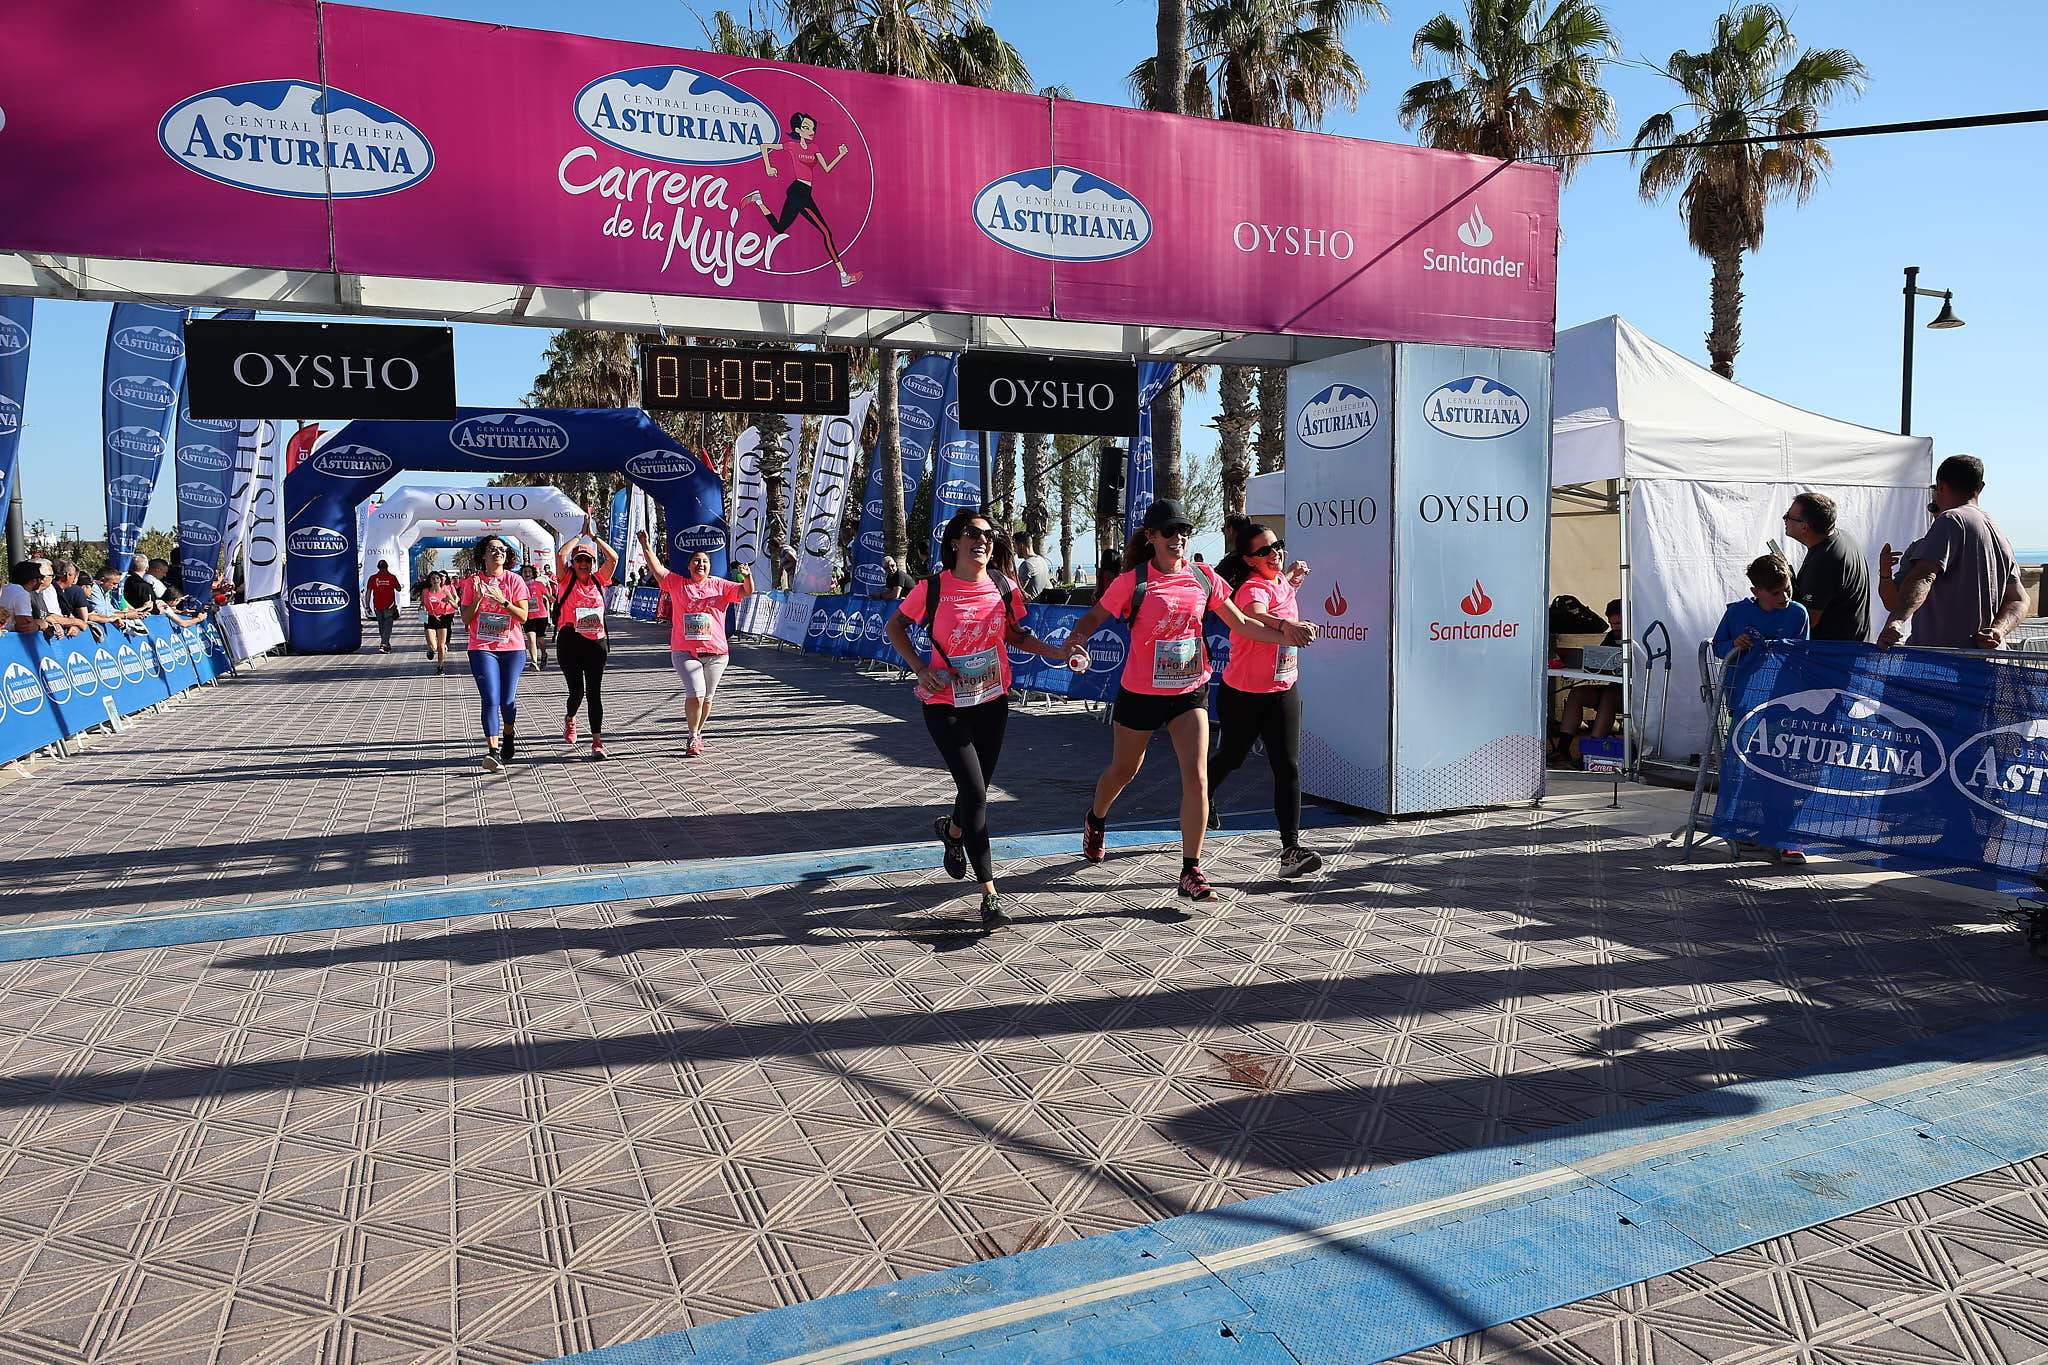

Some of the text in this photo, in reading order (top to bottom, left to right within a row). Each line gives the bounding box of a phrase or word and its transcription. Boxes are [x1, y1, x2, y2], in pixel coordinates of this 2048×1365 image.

[591, 92, 764, 146] ASTURIANA
[623, 93, 760, 119] CENTRAL LECHERA
[224, 114, 311, 133] CENTRAL
[182, 113, 415, 175] ASTURIANA
[558, 146, 728, 209] Carrera
[987, 194, 1140, 241] ASTURIANA
[1015, 195, 1134, 214] CENTRAL LECHERA
[602, 205, 790, 287] de la Mujer
[1233, 222, 1355, 262] OYSHO
[1423, 247, 1525, 279] Santander
[233, 352, 419, 391] OYSHO
[656, 356, 834, 402] 01:05:57
[988, 378, 1115, 411] OYSHO
[1447, 397, 1518, 406] CENTRAL LECHERA
[899, 412, 931, 428] STURIANA
[1312, 401, 1369, 417] CENTRAL LECHERA
[1430, 398, 1522, 425] ASTURIANA
[1301, 410, 1371, 437] ASTURIANA
[459, 426, 561, 449] ASTURIANA
[181, 451, 228, 468] ASTURIANA
[317, 456, 386, 470] ASTURIANA
[631, 461, 692, 474] ASTURIANA
[943, 447, 979, 462] ASTURIA
[178, 489, 223, 505] ASTURIANA
[805, 418, 855, 557] OYSHO
[434, 493, 528, 511] OYSHO
[734, 451, 763, 566] OYSHO
[1297, 496, 1377, 529] OYSHO
[1419, 494, 1529, 523] OYSHO
[290, 537, 344, 550] ASTURIANA
[292, 592, 346, 605] ASTURIANA
[1316, 621, 1368, 641] ntander
[1429, 620, 1520, 642] Santander
[1089, 650, 1121, 662] STURIANA
[1780, 717, 1922, 745] CENTRAL LECHERA
[1744, 716, 1926, 779] ASTURIANA
